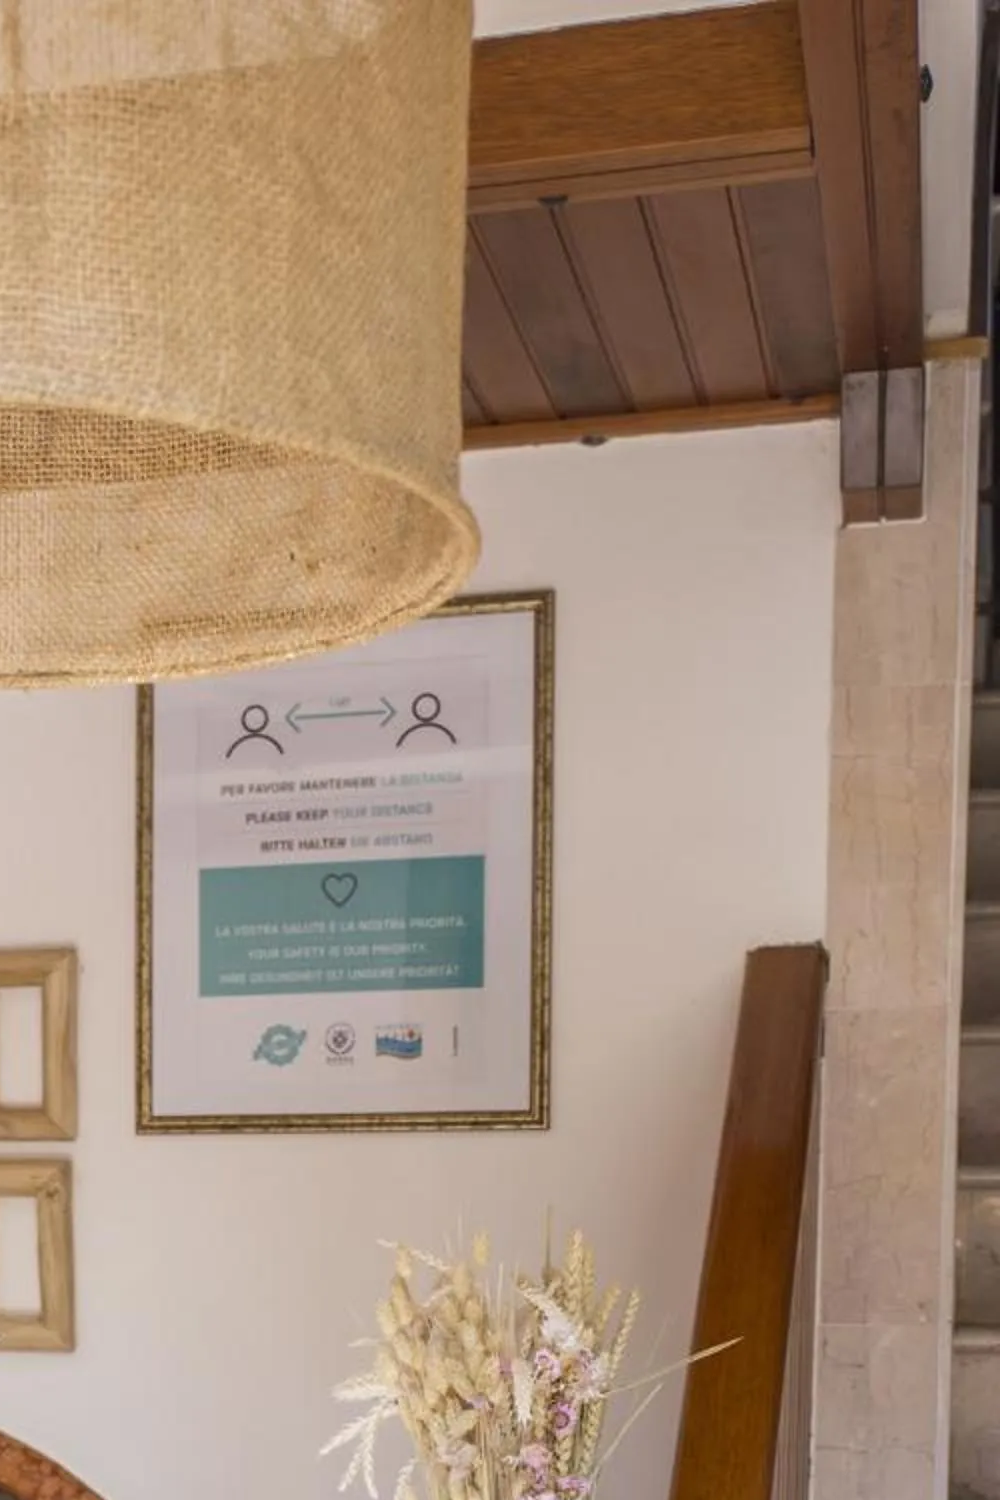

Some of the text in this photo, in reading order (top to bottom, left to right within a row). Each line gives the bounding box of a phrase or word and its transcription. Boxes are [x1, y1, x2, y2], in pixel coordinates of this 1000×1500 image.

[220, 783, 245, 797] PER
[249, 781, 296, 796] FAVORE
[300, 775, 377, 793] MANTENERE
[245, 801, 434, 825] PLEASE KEEP YOUR DISTANCE
[260, 838, 295, 853] BITTE
[298, 836, 347, 851] HALTEN
[373, 831, 433, 848] ABSTAND
[248, 947, 279, 960] YOUR
[282, 944, 325, 959] SAFETY
[343, 943, 370, 957] OUR
